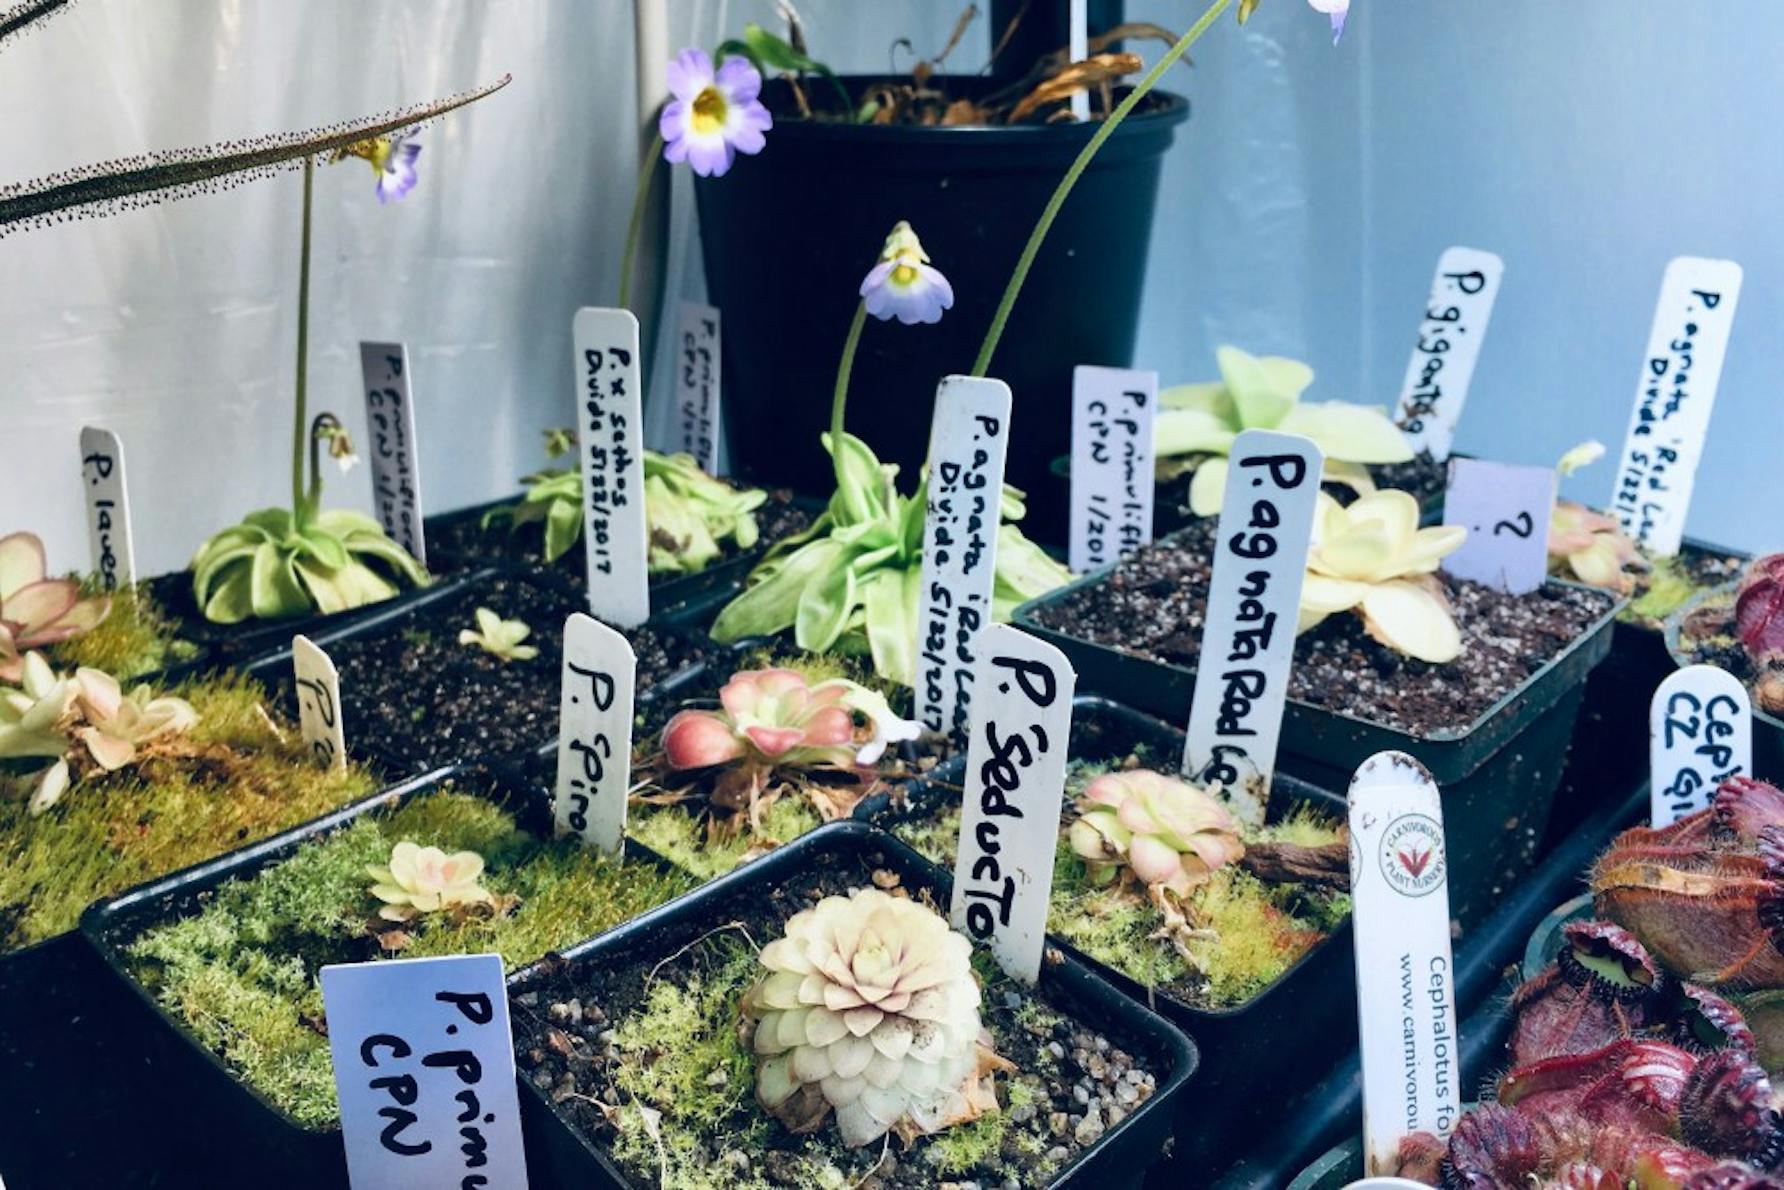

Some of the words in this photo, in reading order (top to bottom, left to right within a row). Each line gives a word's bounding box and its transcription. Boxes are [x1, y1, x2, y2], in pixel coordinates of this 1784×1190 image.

[1686, 289, 1721, 312] P.
[608, 347, 631, 371] P.
[368, 388, 394, 459] CPN
[973, 414, 1000, 442] P.
[1122, 390, 1148, 414] P.
[1087, 401, 1110, 464] CPN
[83, 452, 114, 486] P.
[1238, 453, 1308, 490] P.
[934, 462, 962, 567] Divide
[963, 449, 988, 575] agnata
[1087, 494, 1112, 574] 1/201
[1472, 510, 1534, 539] ?
[922, 581, 951, 733] 5/22/2017
[991, 655, 1058, 708] P.
[296, 677, 336, 728] P.
[567, 660, 615, 713] P.
[1386, 860, 1411, 889] PLANT
[435, 990, 494, 1036] P.
[1427, 956, 1451, 1099] Cephalotus
[1400, 953, 1419, 1132] www.carnivorou
[359, 1033, 433, 1156] CPN
